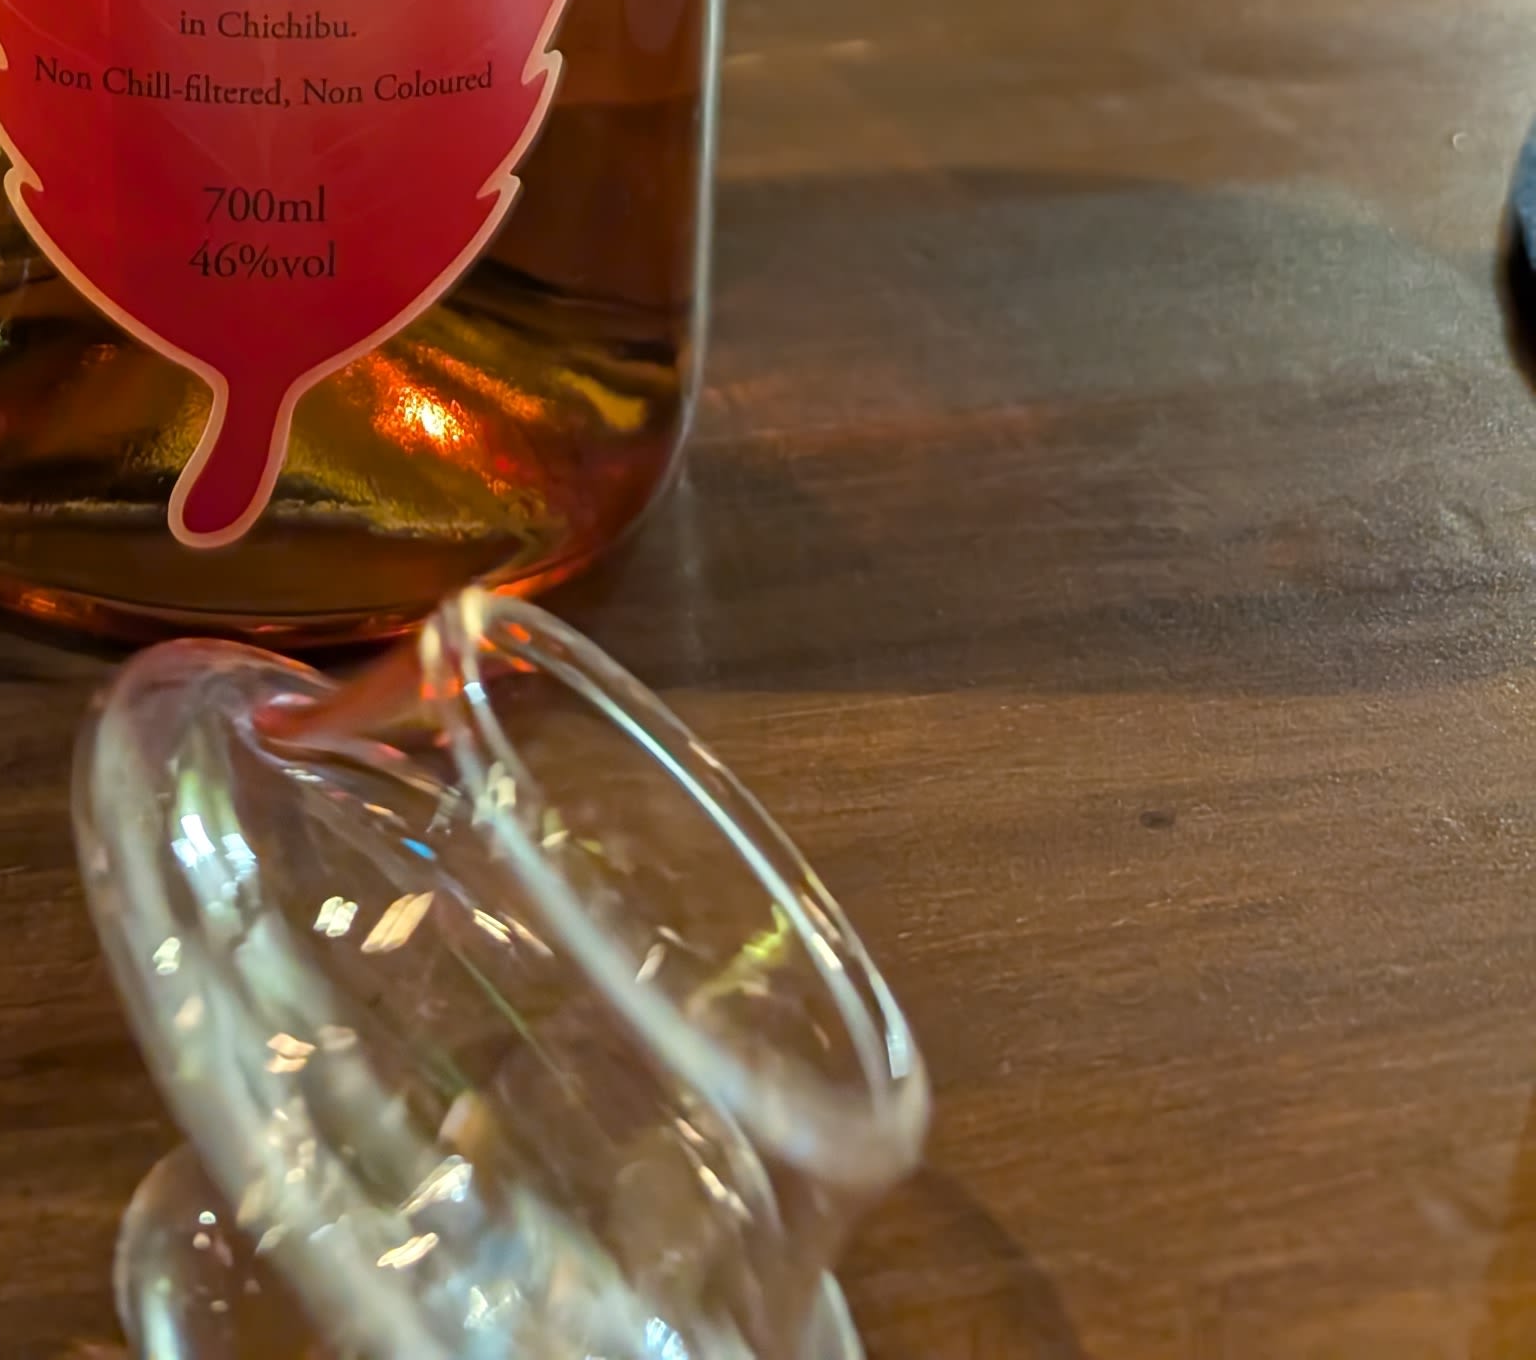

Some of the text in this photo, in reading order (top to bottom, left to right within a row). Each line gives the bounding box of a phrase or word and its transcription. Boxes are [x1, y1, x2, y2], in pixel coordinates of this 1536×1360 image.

[179, 9, 358, 40] in Chichibu.
[33, 55, 494, 109] Non Chill-filtered, Non Coloured
[202, 184, 327, 224] 700ml
[188, 241, 337, 280] 46%vol
